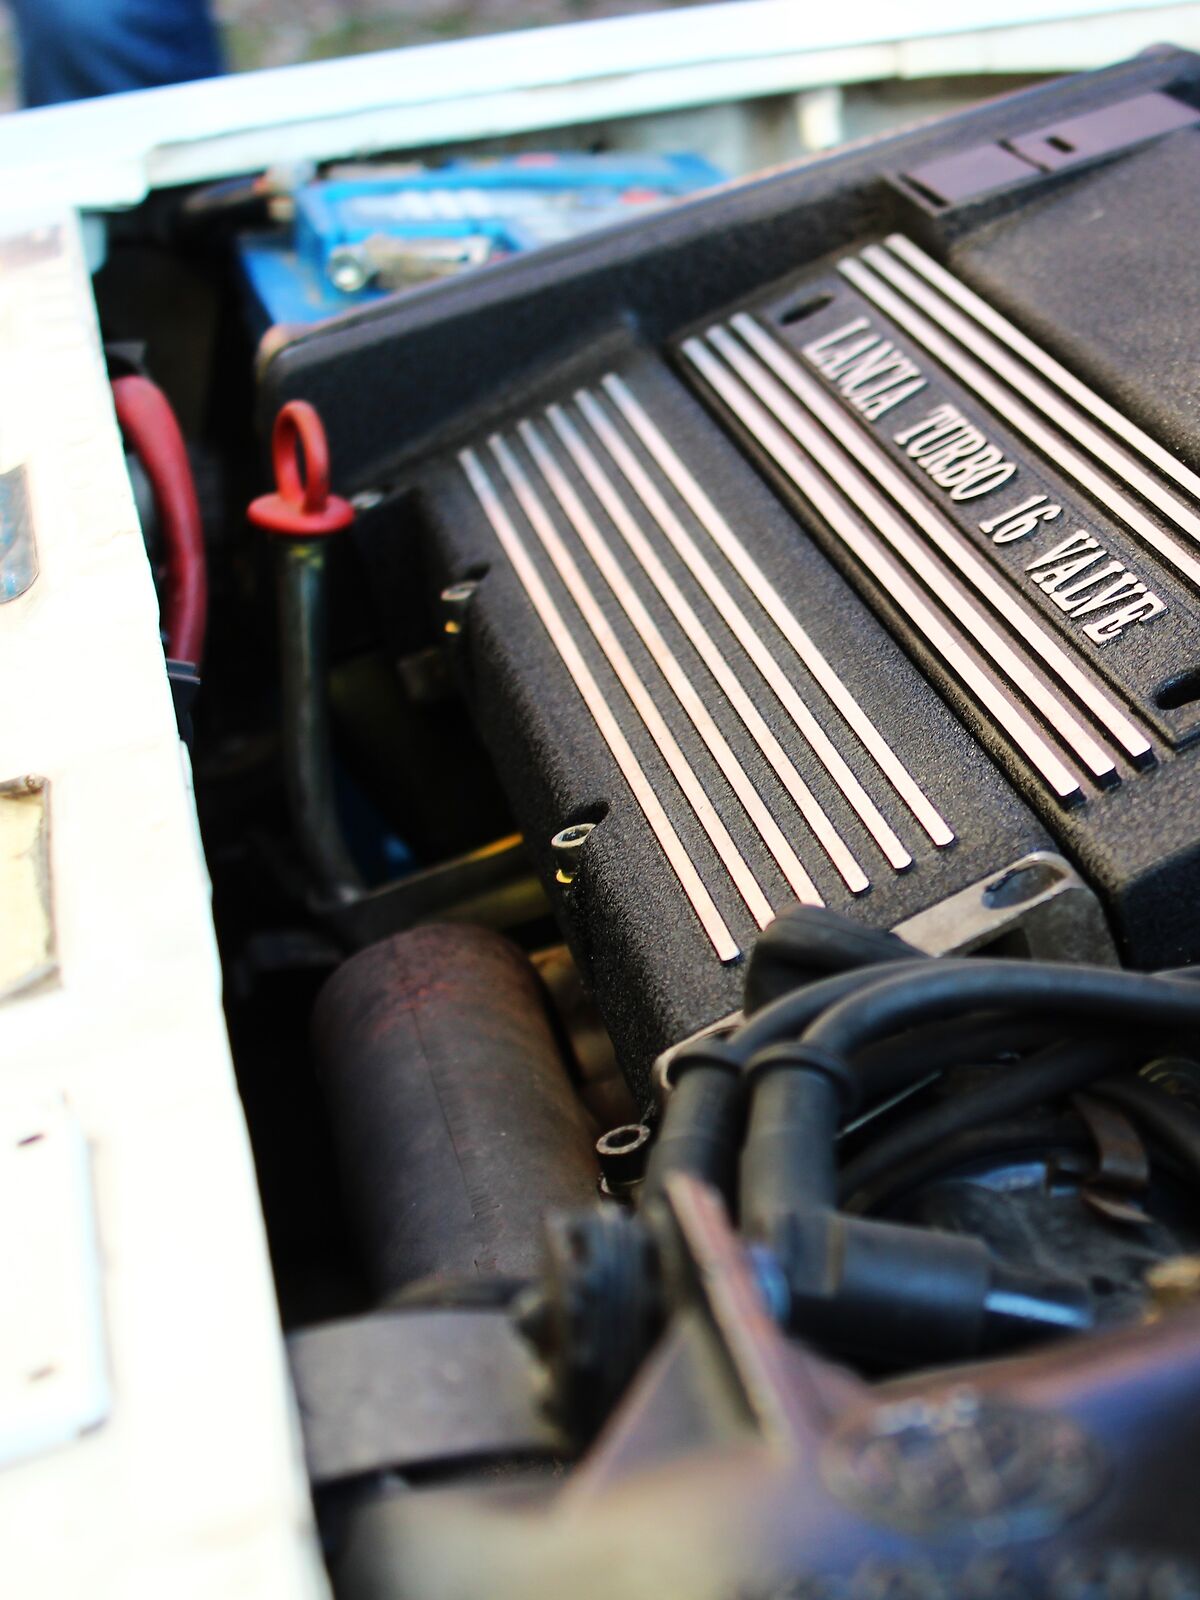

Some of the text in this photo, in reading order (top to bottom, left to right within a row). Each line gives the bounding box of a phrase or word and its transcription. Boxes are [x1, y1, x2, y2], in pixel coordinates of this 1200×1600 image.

[802, 316, 1169, 645] LANCIA TURBO 16 VALVE
